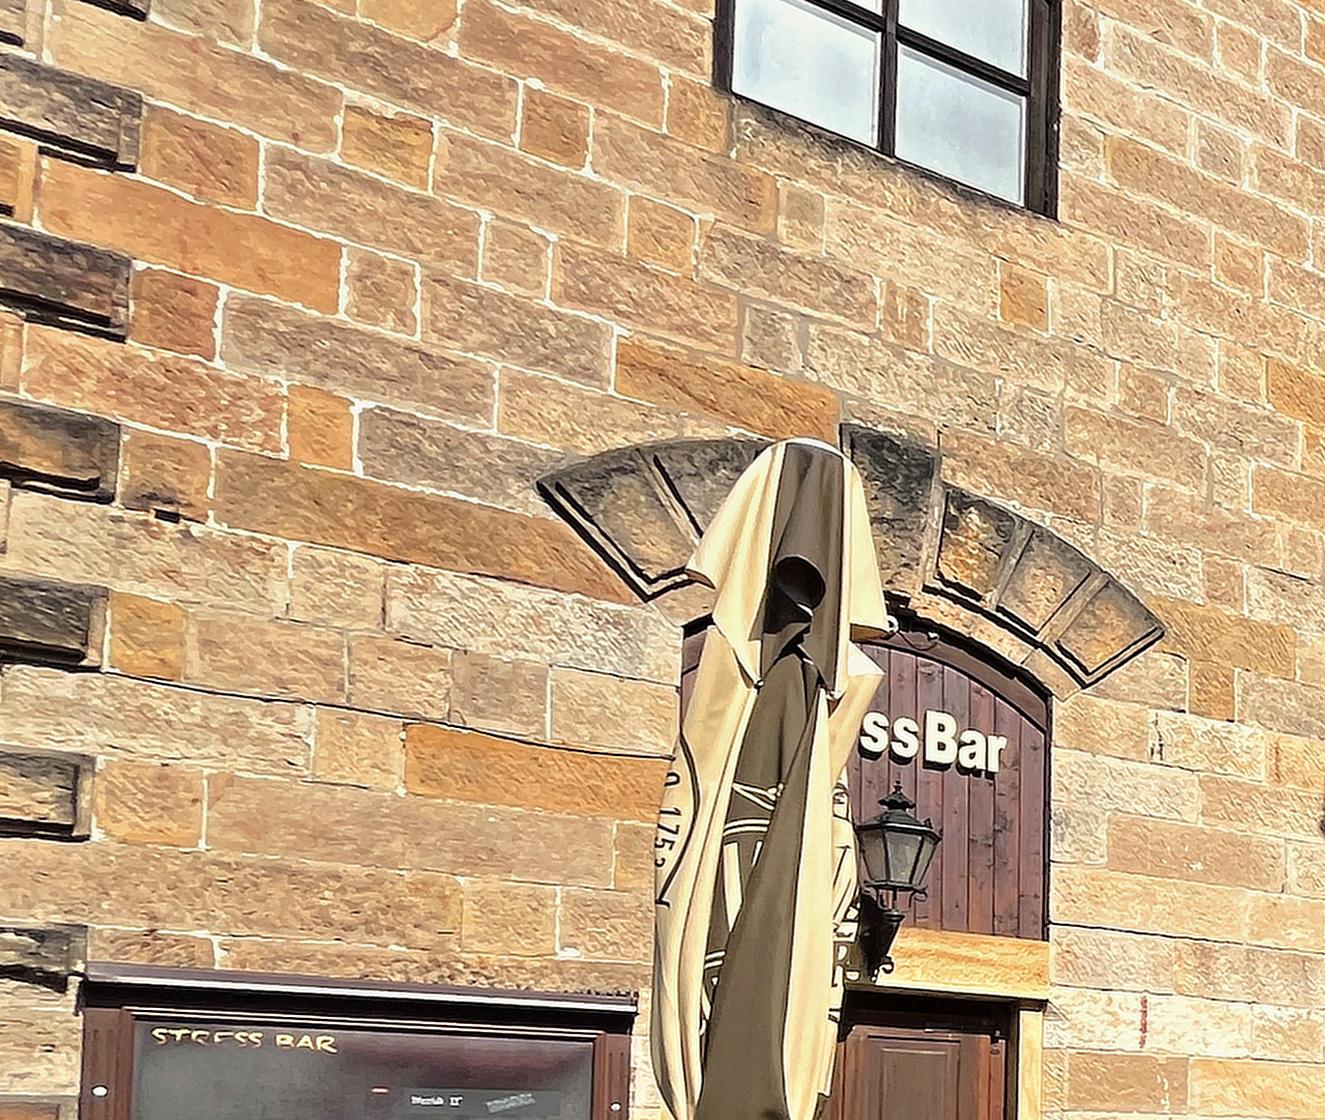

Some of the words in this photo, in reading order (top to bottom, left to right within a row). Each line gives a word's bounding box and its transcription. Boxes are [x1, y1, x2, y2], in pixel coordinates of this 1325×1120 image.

[859, 710, 1007, 776] ssBar
[151, 1028, 264, 1049] STRESS
[275, 1034, 338, 1053] BAR
